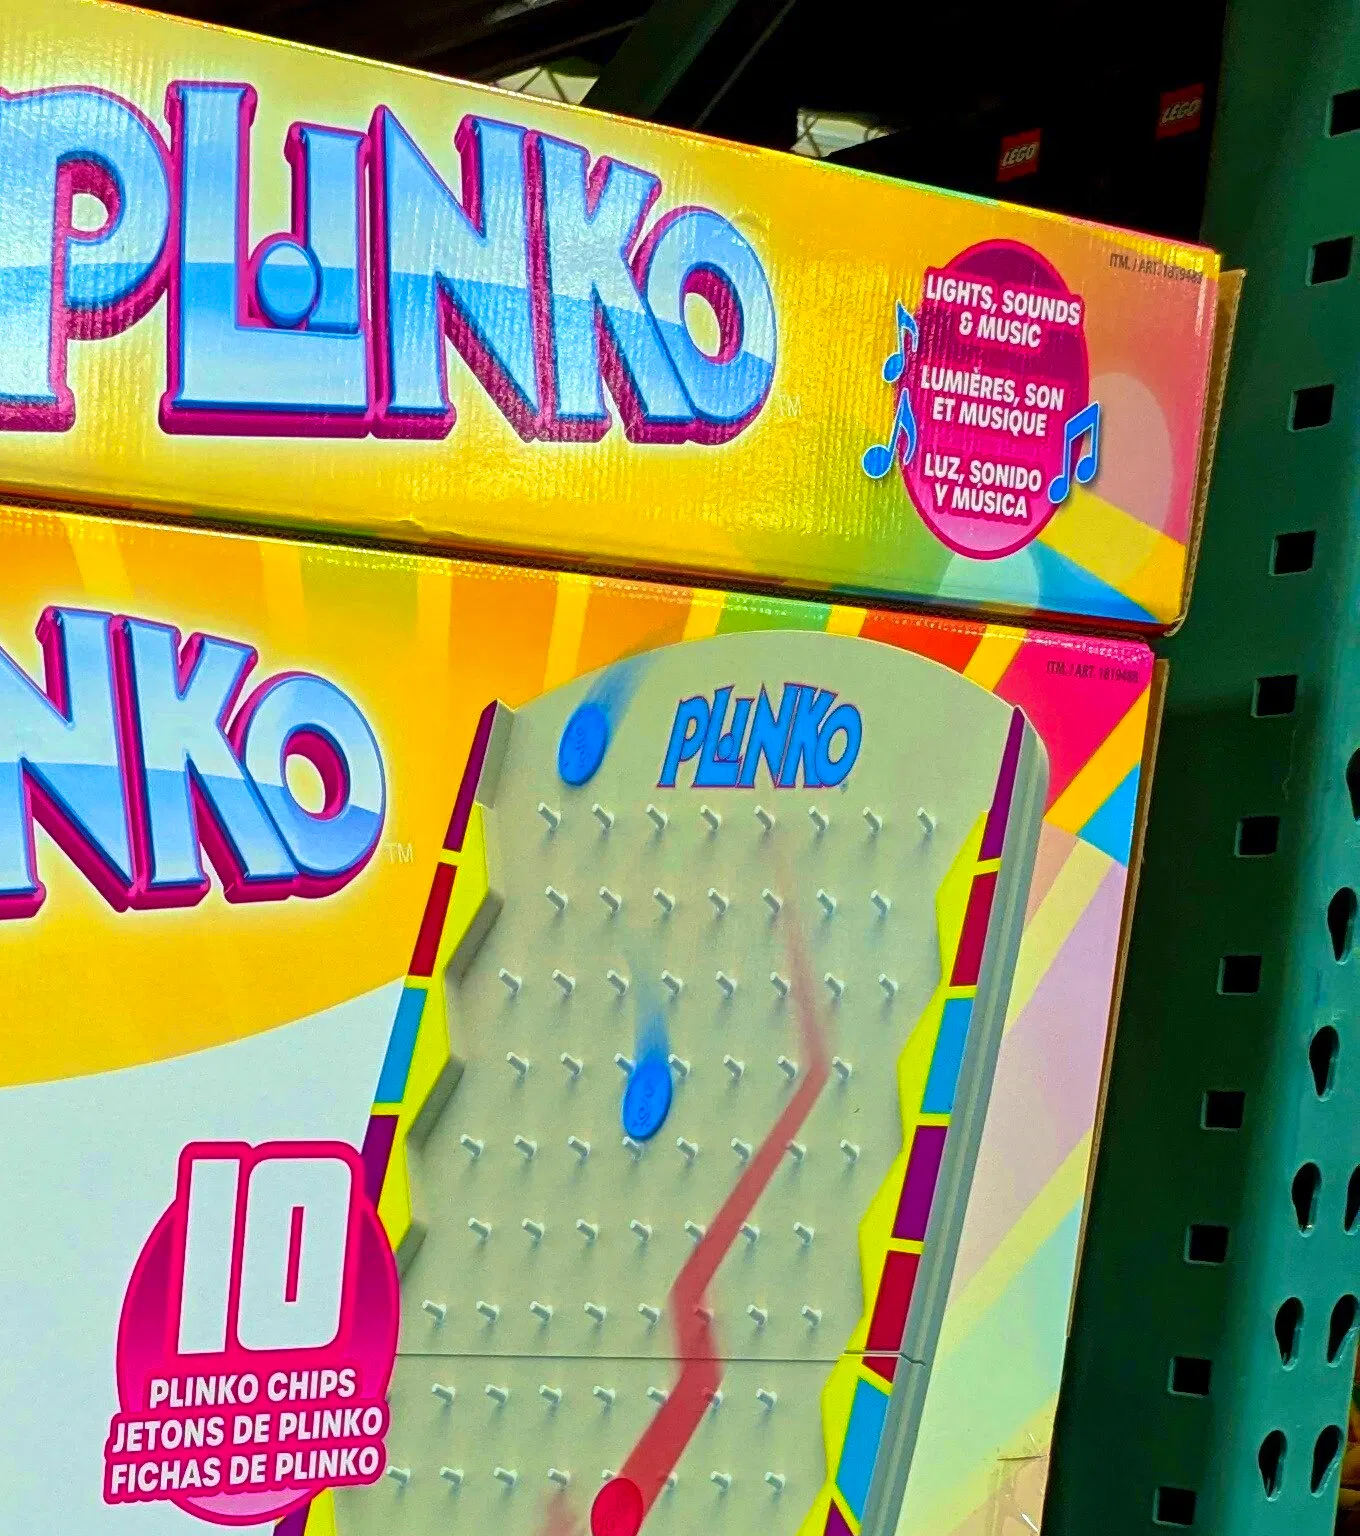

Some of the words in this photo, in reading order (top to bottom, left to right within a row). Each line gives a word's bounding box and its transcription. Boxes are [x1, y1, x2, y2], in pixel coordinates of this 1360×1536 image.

[1160, 97, 1202, 125] LEGO
[1000, 142, 1040, 168] LEGO
[926, 274, 996, 314] LIGHTS,
[1002, 290, 1080, 326] SOUNDS
[959, 312, 973, 335] &
[977, 314, 1041, 348] MUSIC
[921, 365, 1021, 407] LUMIÈRES,
[1025, 383, 1064, 411] SON
[933, 397, 955, 421] ET
[959, 401, 1047, 437] MUSIQUE
[924, 452, 964, 485] LUZ,
[970, 462, 1042, 492] SONIDO
[934, 484, 947, 506] Y
[952, 483, 1027, 518] MÚSICA
[656, 682, 862, 789] PLINKO
[178, 1158, 352, 1354] 10
[149, 1374, 259, 1409] PLINKO
[267, 1368, 356, 1400] CHIPS
[112, 1417, 224, 1453] JETONS
[233, 1413, 270, 1445] DE
[279, 1407, 382, 1441] PLINKO
[111, 1458, 221, 1494] FICHAS
[229, 1454, 267, 1485] DE
[275, 1446, 379, 1481] PLINKO
